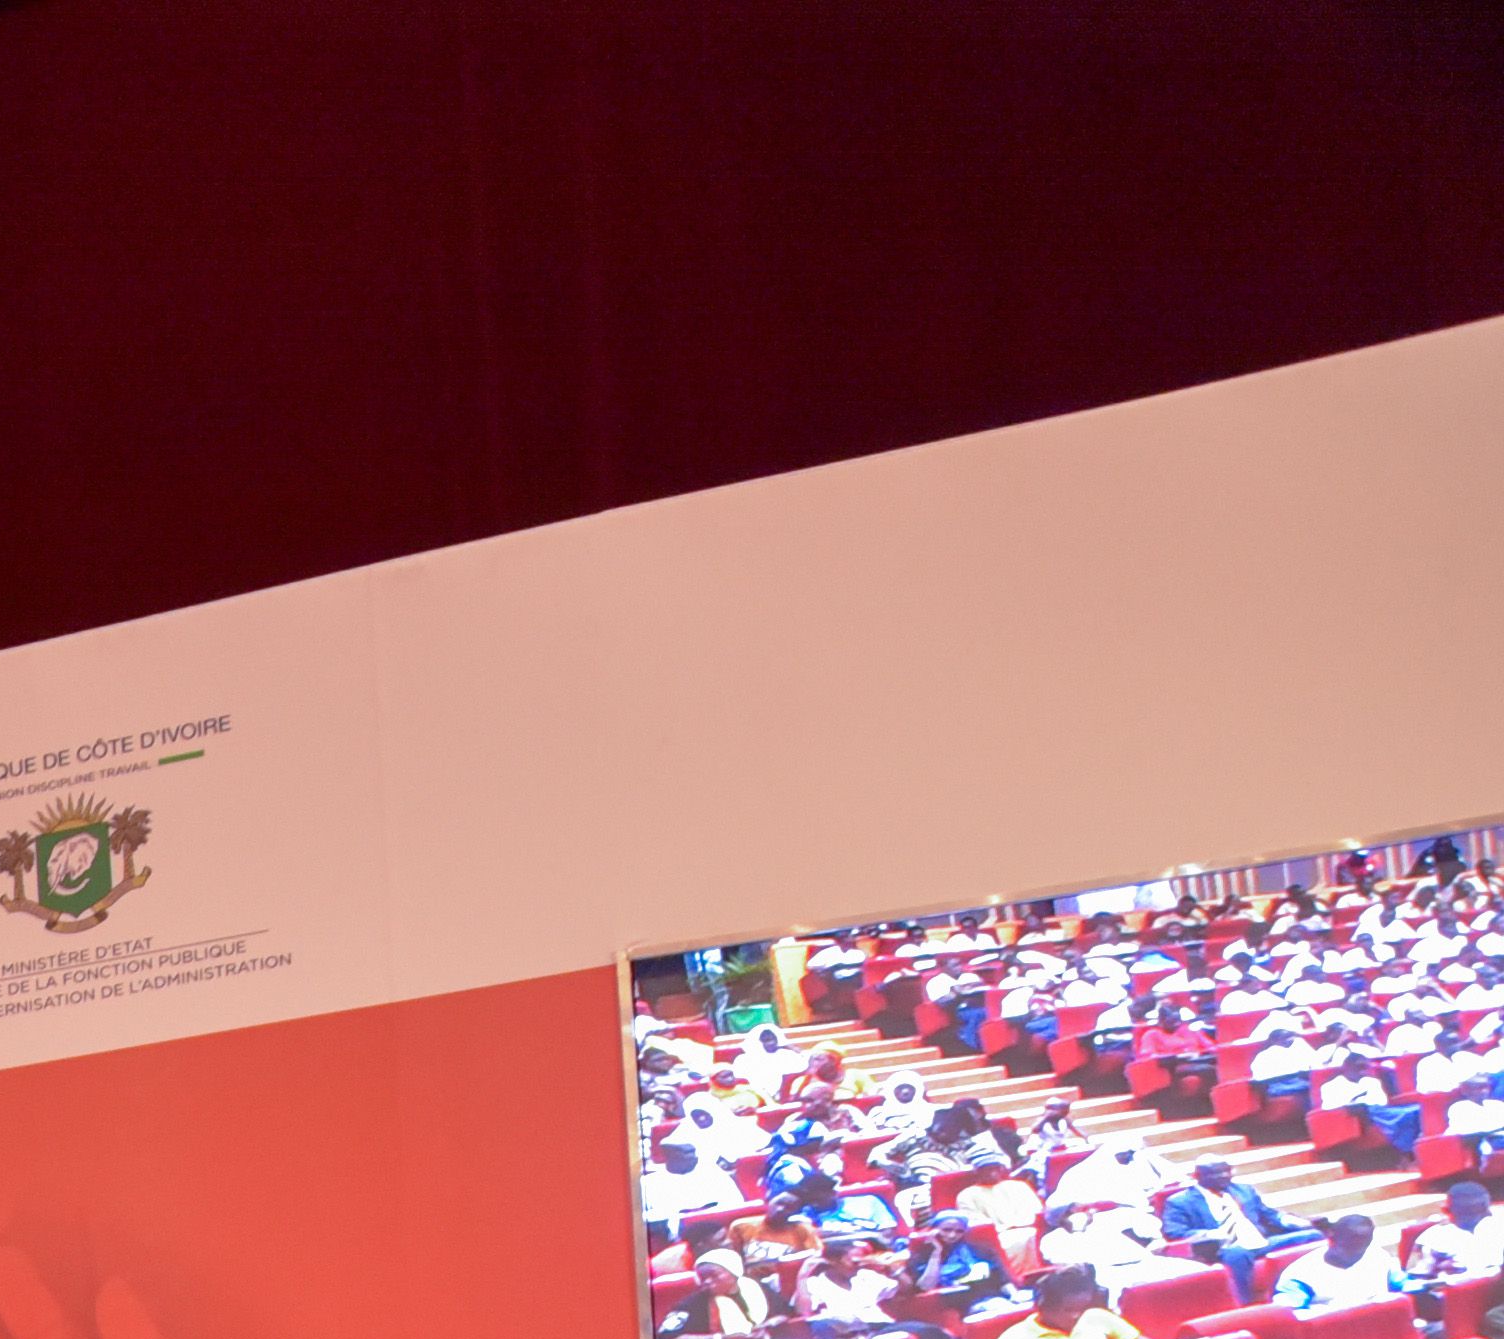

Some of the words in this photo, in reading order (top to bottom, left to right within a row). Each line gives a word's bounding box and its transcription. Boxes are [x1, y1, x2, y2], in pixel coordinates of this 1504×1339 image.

[43, 749, 70, 770] DE
[76, 736, 133, 762] CÔTE
[27, 772, 95, 794] DISCIPLINE
[100, 761, 151, 778] TRAVAIL
[2, 949, 90, 976] MINISTÈRE
[8, 980, 29, 996] DE
[36, 976, 57, 990] LA
[63, 958, 153, 985] FONCTION
[159, 940, 246, 968] PUBLIQUE
[101, 983, 123, 999] DE
